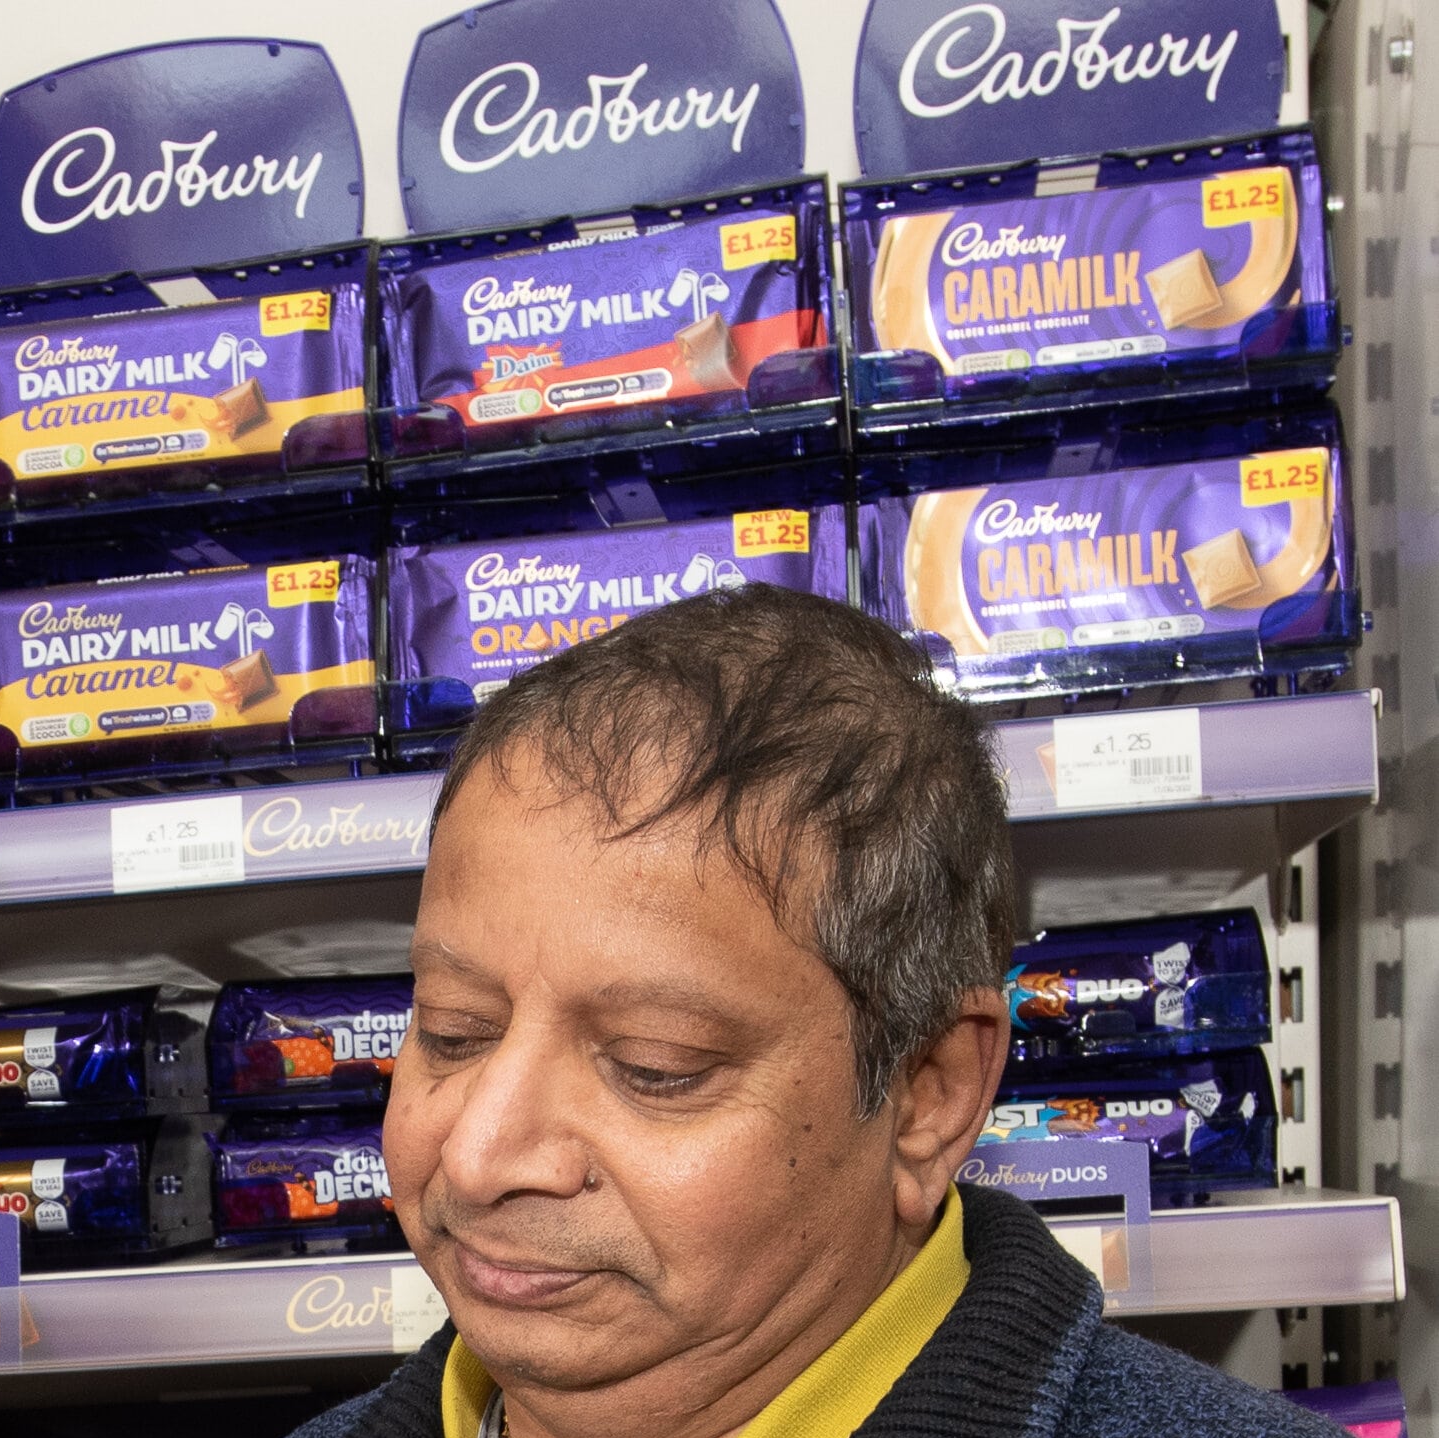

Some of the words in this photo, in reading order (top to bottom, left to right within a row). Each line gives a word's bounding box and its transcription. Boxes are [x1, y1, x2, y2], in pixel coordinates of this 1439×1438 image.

[899, 3, 1239, 119] Cadbury
[440, 62, 760, 172] Cadbury
[21, 127, 322, 234] Cadbury
[1208, 184, 1280, 211] £1.25
[726, 226, 793, 255] £1.25
[942, 222, 1066, 266] Cadbury
[463, 277, 572, 315] Cadbury
[943, 251, 1143, 325] CARAMILK
[264, 297, 328, 322] £1.25
[467, 302, 577, 346] DAIRY
[581, 288, 671, 328] MILK
[15, 335, 118, 371] Cadbury
[493, 352, 554, 382] Daim
[18, 361, 122, 401] DAIRY
[126, 351, 210, 388] MILK
[22, 392, 173, 431] Caramel
[1246, 463, 1320, 490] £1.25
[750, 510, 793, 524] NEW
[974, 499, 1102, 544] Cadbury
[738, 524, 806, 547] £1.25
[271, 569, 337, 592] £1.25
[465, 552, 581, 591] Cadbury
[977, 529, 1181, 603] CARAMILK
[468, 582, 585, 622] DAIRY
[589, 573, 682, 611] MILK
[18, 601, 122, 639] Cadbury
[21, 629, 122, 669] DAIRY
[131, 620, 217, 656] MILK
[25, 661, 180, 699] Caramel
[36, 730, 68, 740] COCOA
[243, 797, 429, 857] Cadbury
[1076, 978, 1144, 1004] DUO
[352, 1008, 413, 1032] dou
[332, 1027, 408, 1061] DECK
[30, 1078, 55, 1087] SAVE
[1105, 1098, 1174, 1118] DUO
[333, 1151, 385, 1175] dou
[1051, 1165, 1108, 1184] DUOS
[314, 1170, 392, 1204] DECK
[38, 1210, 62, 1218] SAVE
